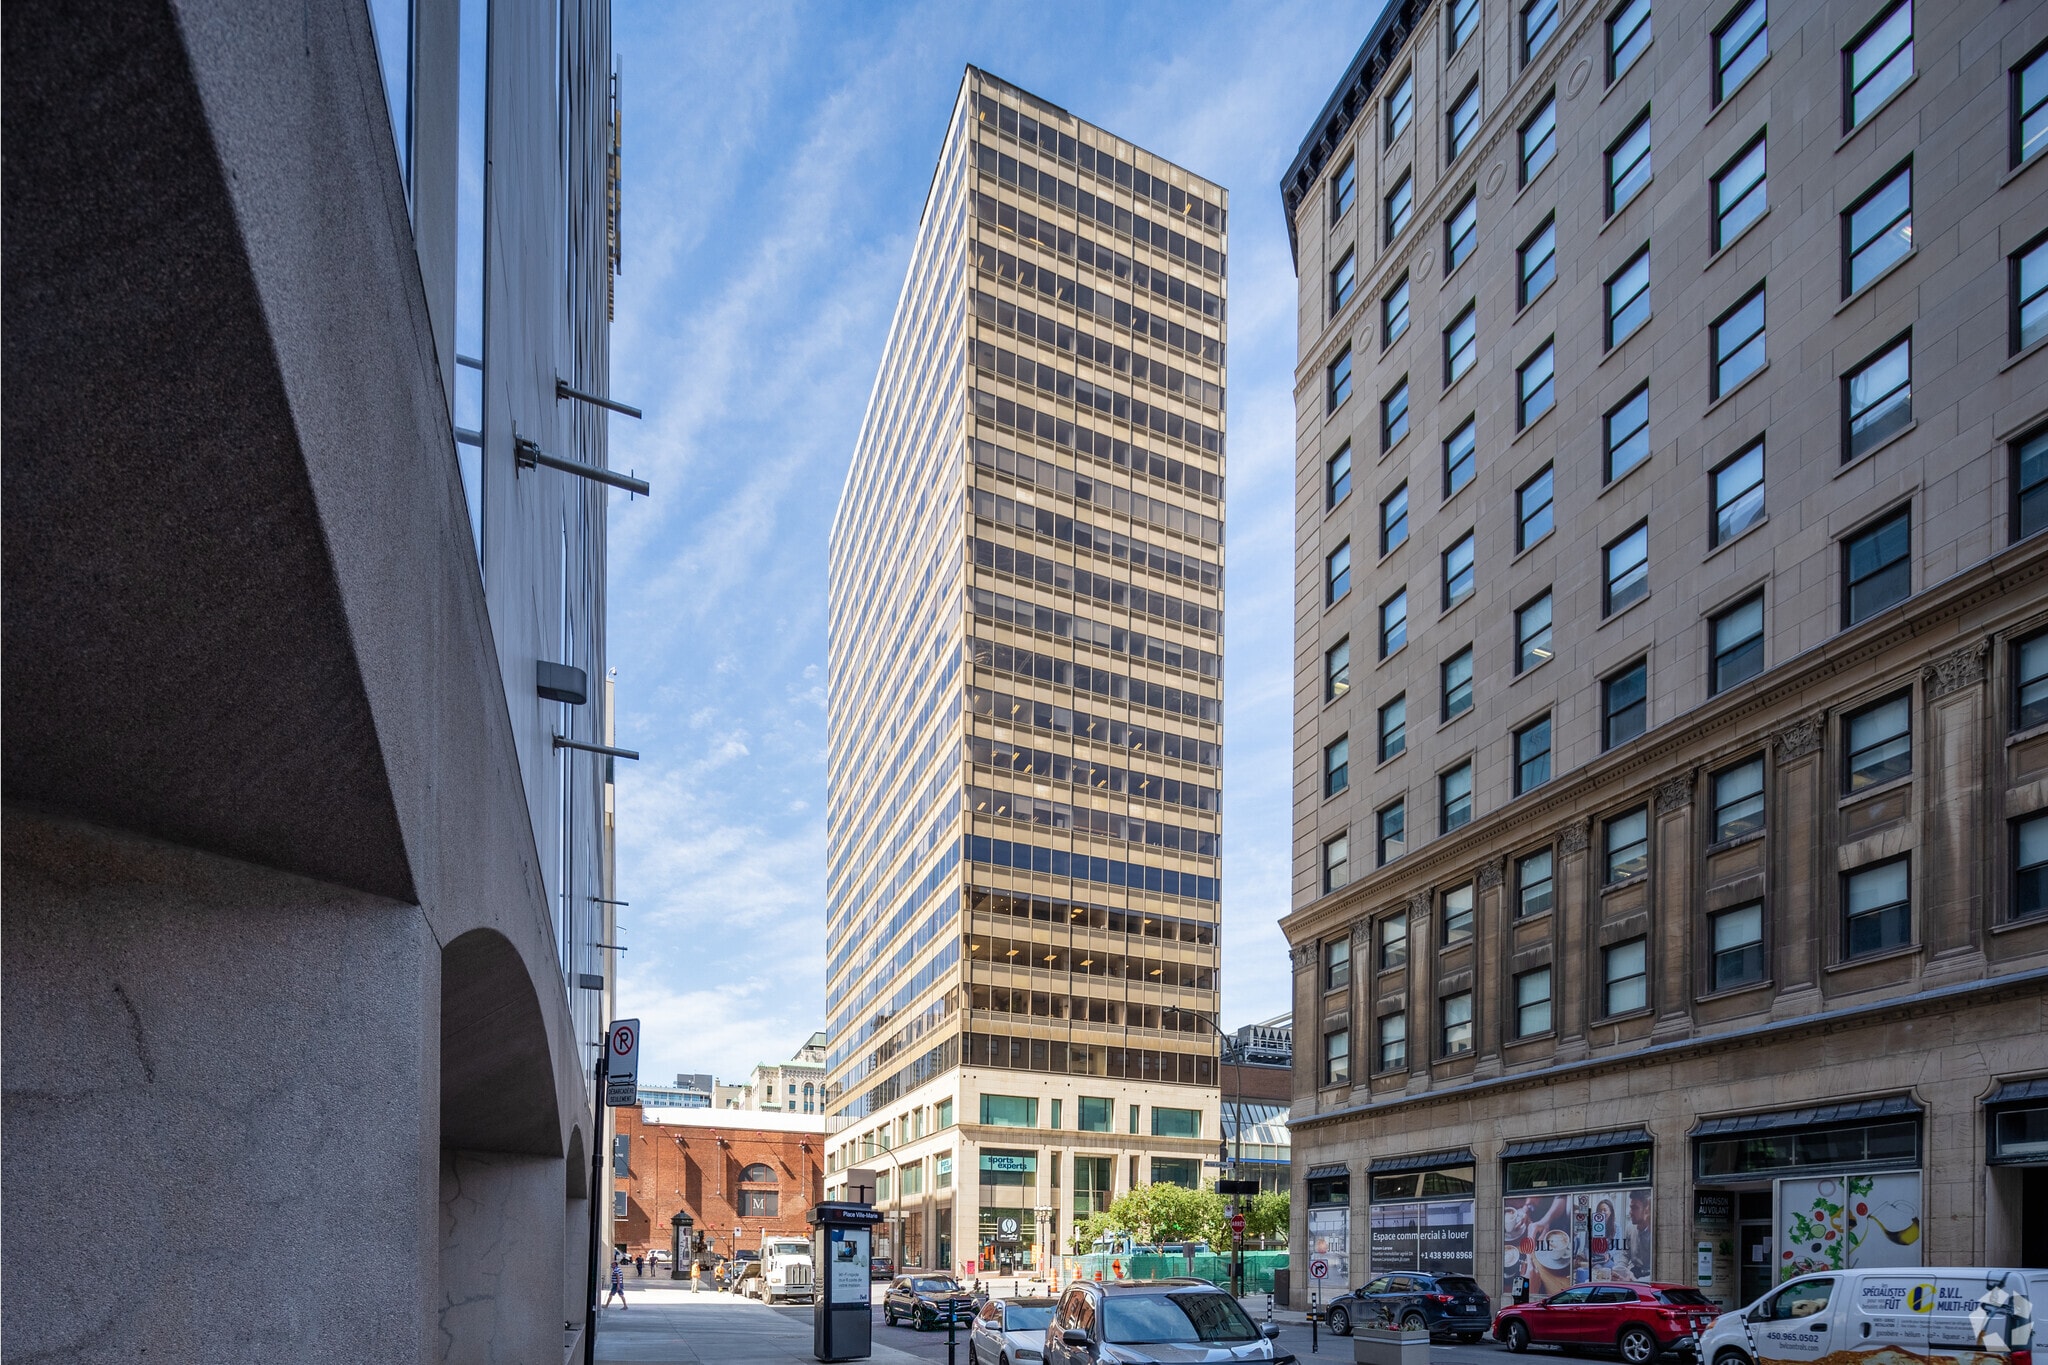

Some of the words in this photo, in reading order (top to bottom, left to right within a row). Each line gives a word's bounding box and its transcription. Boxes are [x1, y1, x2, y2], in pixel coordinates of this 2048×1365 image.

[988, 1156, 1014, 1165] sports
[997, 1162, 1027, 1170] experts
[752, 1198, 764, 1210] M
[1700, 1196, 1729, 1205] LIVRAISON
[842, 1210, 856, 1218] Place
[1698, 1205, 1707, 1214] AU
[1707, 1206, 1729, 1214] VOLANT
[1373, 1232, 1396, 1242] Espace
[1397, 1230, 1441, 1241] commercial
[1442, 1229, 1447, 1239] à
[1448, 1229, 1469, 1239] louer
[1535, 1240, 1553, 1251] JLL
[1608, 1238, 1629, 1251] JLL
[1442, 1251, 1455, 1259] 990
[1456, 1251, 1473, 1259] 8968
[1862, 1285, 1907, 1297] SPÉCIALISTES
[1939, 1287, 1963, 1298] B.V.L.
[1884, 1296, 1901, 1310] FÛT
[1937, 1299, 1980, 1311] MULTI-FÛT
[1766, 1332, 1819, 1342] 450.965.0502
